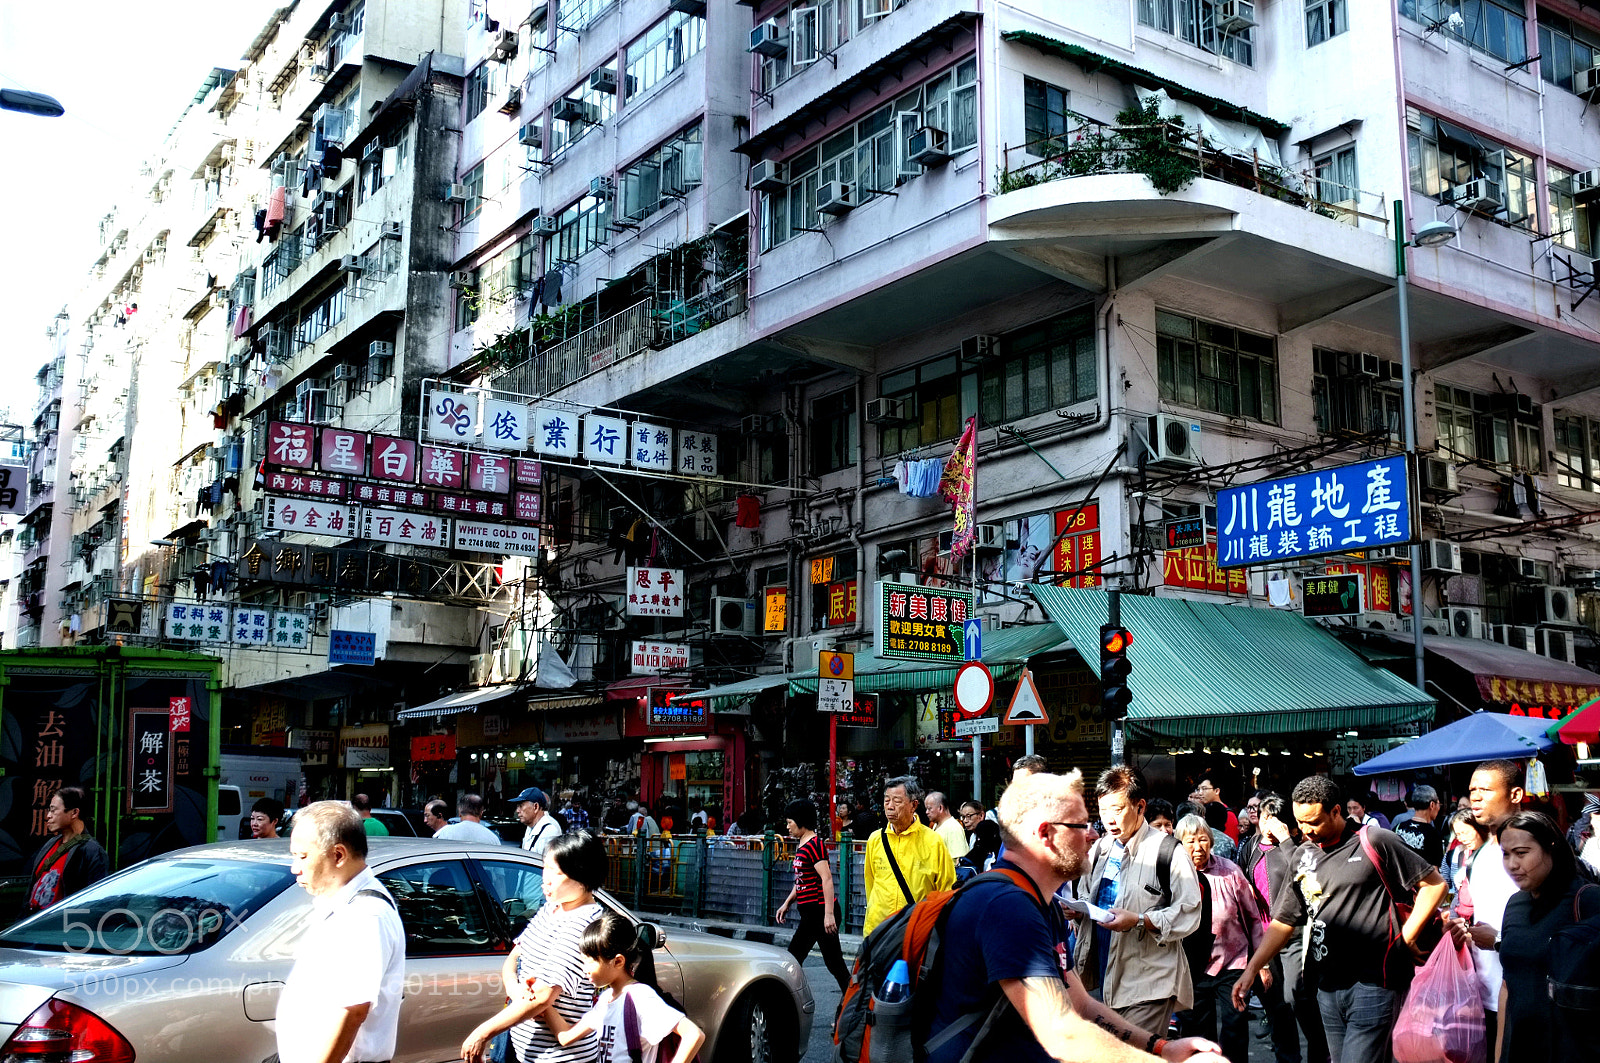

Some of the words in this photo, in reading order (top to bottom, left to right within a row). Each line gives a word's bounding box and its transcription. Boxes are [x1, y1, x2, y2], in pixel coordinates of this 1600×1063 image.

[489, 411, 621, 455] 俊業行
[273, 426, 505, 492] 福星白藥膏
[636, 448, 669, 467] 配件
[682, 455, 714, 473] 用品
[519, 494, 537, 503] PAK
[519, 502, 538, 510] KAM
[1223, 464, 1401, 535] 川龍地產
[279, 504, 344, 531] 白金油
[519, 509, 537, 518] YAU
[376, 517, 436, 541] 百金油
[458, 525, 488, 536] WHITE
[492, 528, 517, 539] GOLD
[521, 532, 537, 541] OIL
[468, 538, 484, 547] 2748
[485, 540, 500, 549] 0802
[636, 570, 675, 593] 恩平
[1305, 579, 1339, 596] 美康健
[172, 606, 223, 623] 配料城
[768, 604, 784, 613] 128
[889, 591, 967, 622] 新美康健
[171, 623, 221, 639] 首飾堡
[889, 620, 946, 639] 歡迎男女賓
[908, 640, 930, 651] 2708
[931, 642, 952, 654] 8189
[633, 653, 645, 666] HOA
[662, 655, 688, 668] COMPANY
[841, 681, 847, 693] 7
[841, 699, 852, 711] 12
[683, 715, 703, 723] 8189
